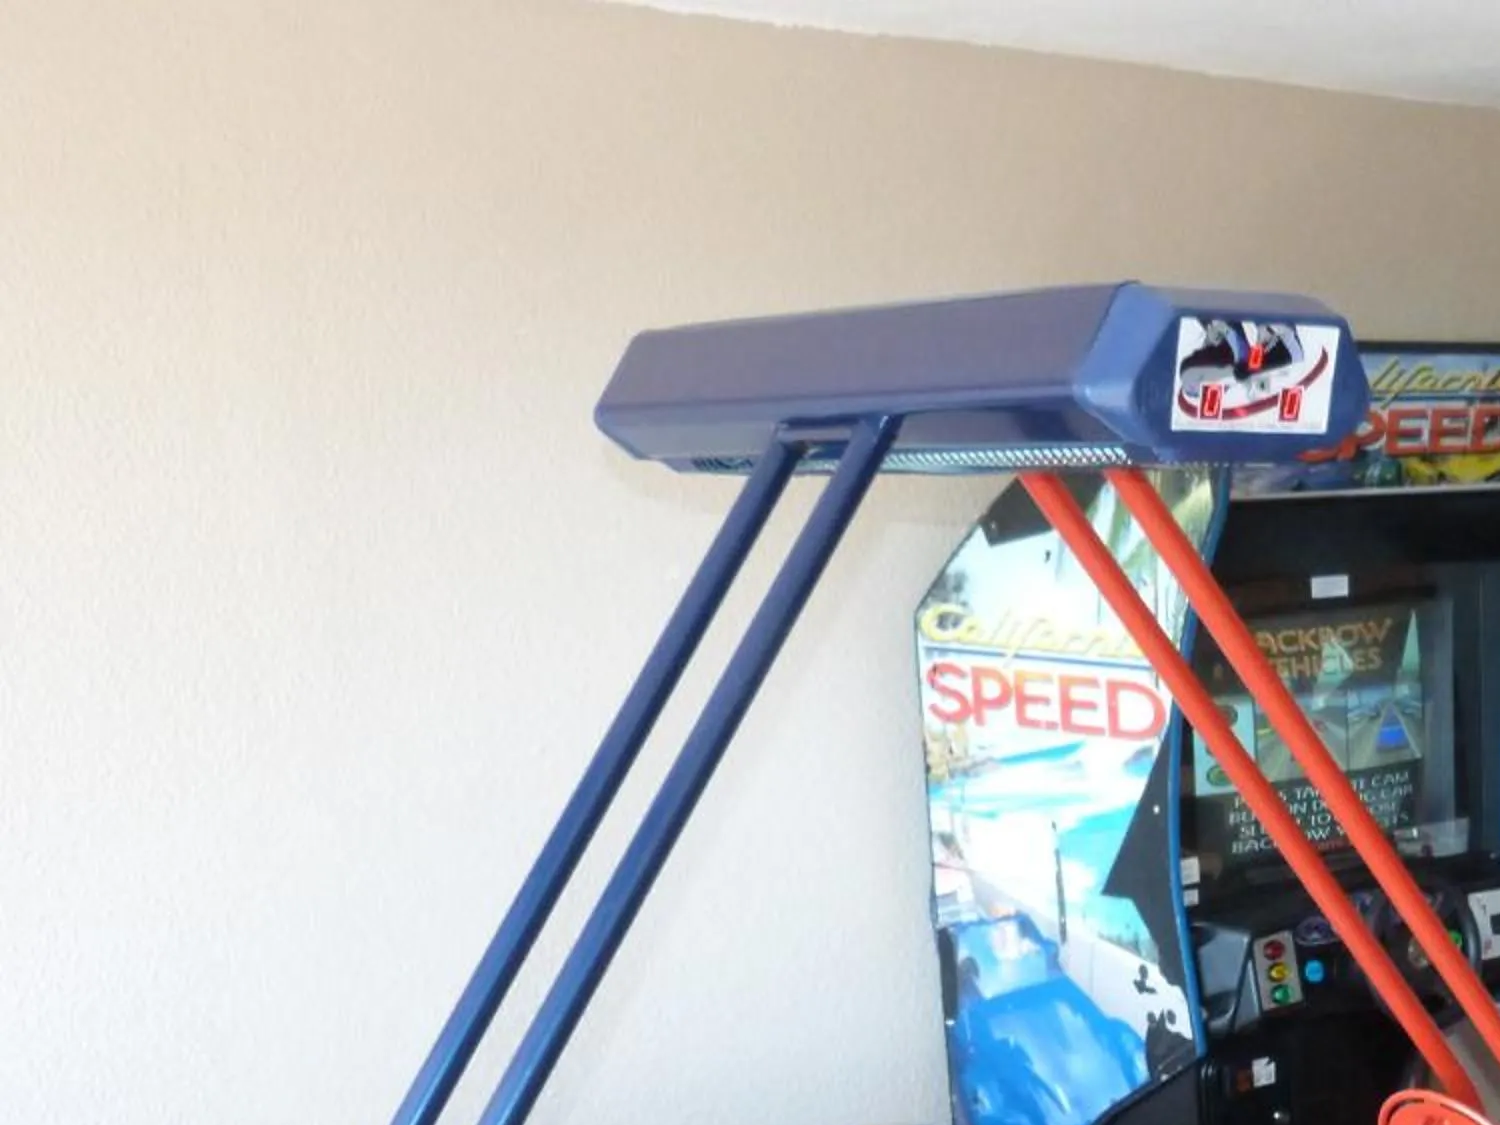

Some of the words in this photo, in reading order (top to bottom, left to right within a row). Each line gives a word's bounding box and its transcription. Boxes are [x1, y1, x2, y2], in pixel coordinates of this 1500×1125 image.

[1254, 617, 1392, 653] ACKROW
[1273, 647, 1383, 680] EHICLES
[925, 661, 1167, 741] SPEED
